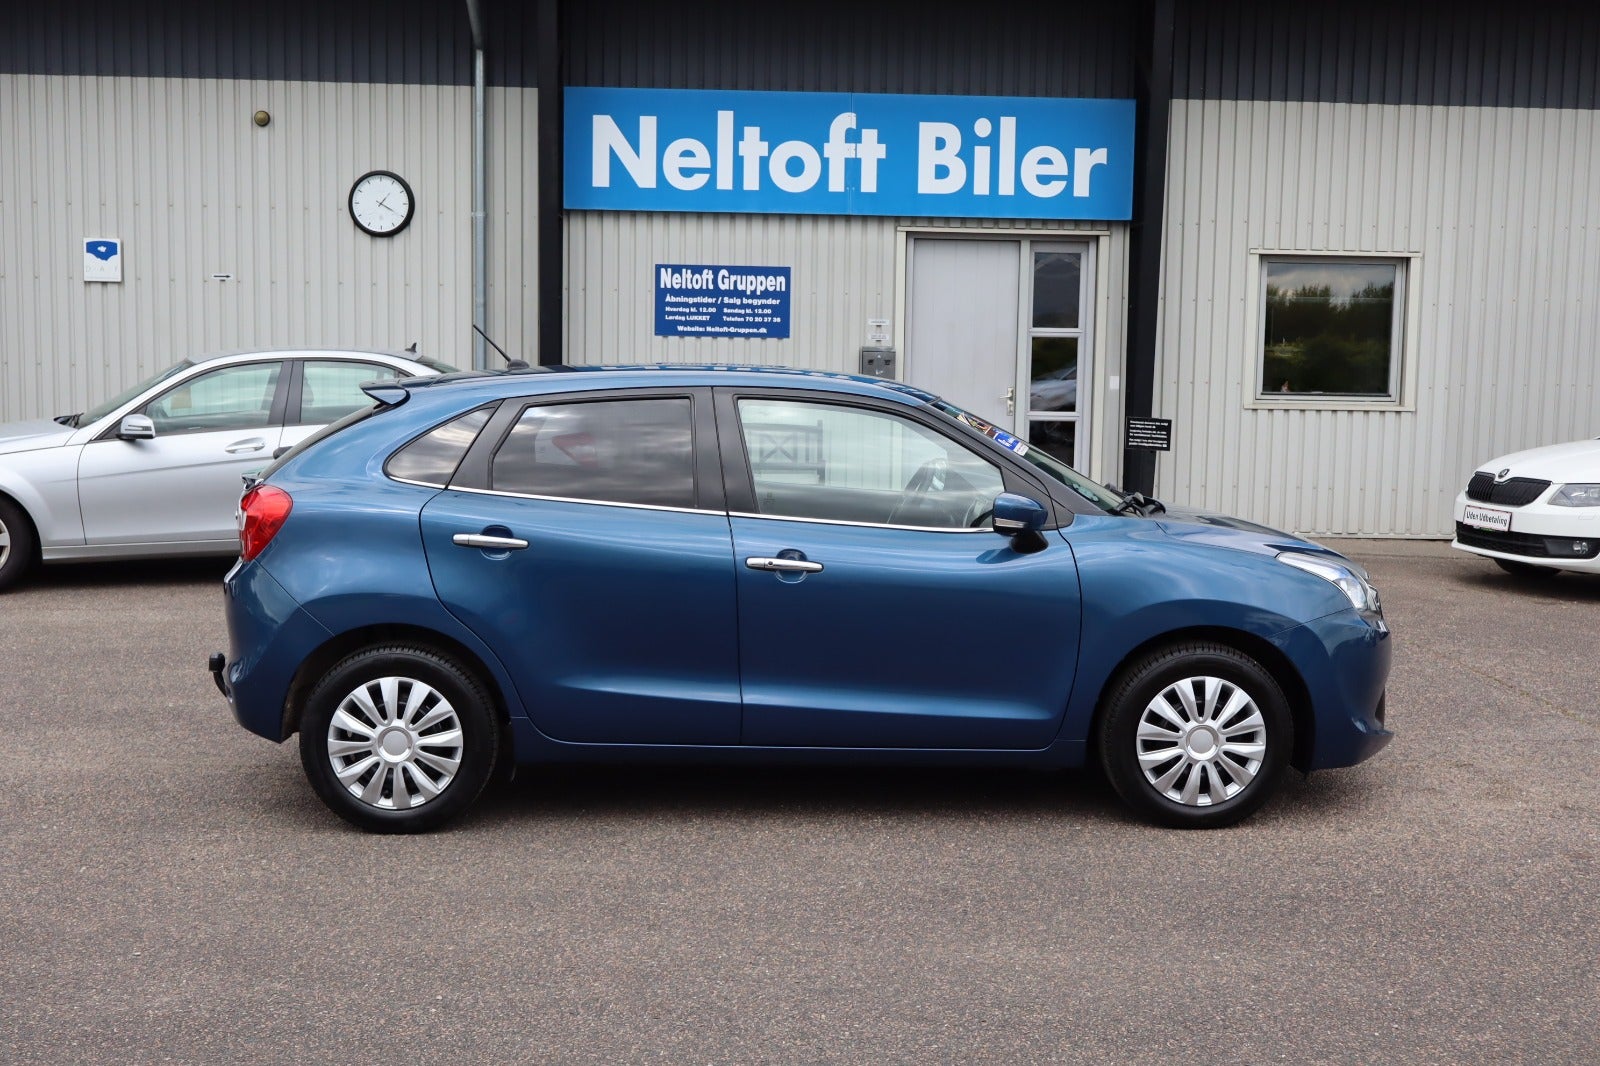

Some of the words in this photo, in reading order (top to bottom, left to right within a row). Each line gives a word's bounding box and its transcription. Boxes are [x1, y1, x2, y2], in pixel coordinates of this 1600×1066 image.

[592, 110, 886, 193] Neltoft
[917, 116, 1107, 198] Biler
[660, 267, 714, 290] Neltoft
[717, 268, 786, 296] Gruppen
[665, 293, 717, 304] Åbningstider
[723, 297, 741, 305] Salg
[742, 297, 781, 306] begynder
[706, 326, 768, 334] Neltoft-Gruppen.dk
[1466, 511, 1479, 520] Uden
[1479, 513, 1508, 527] Udbetaling
